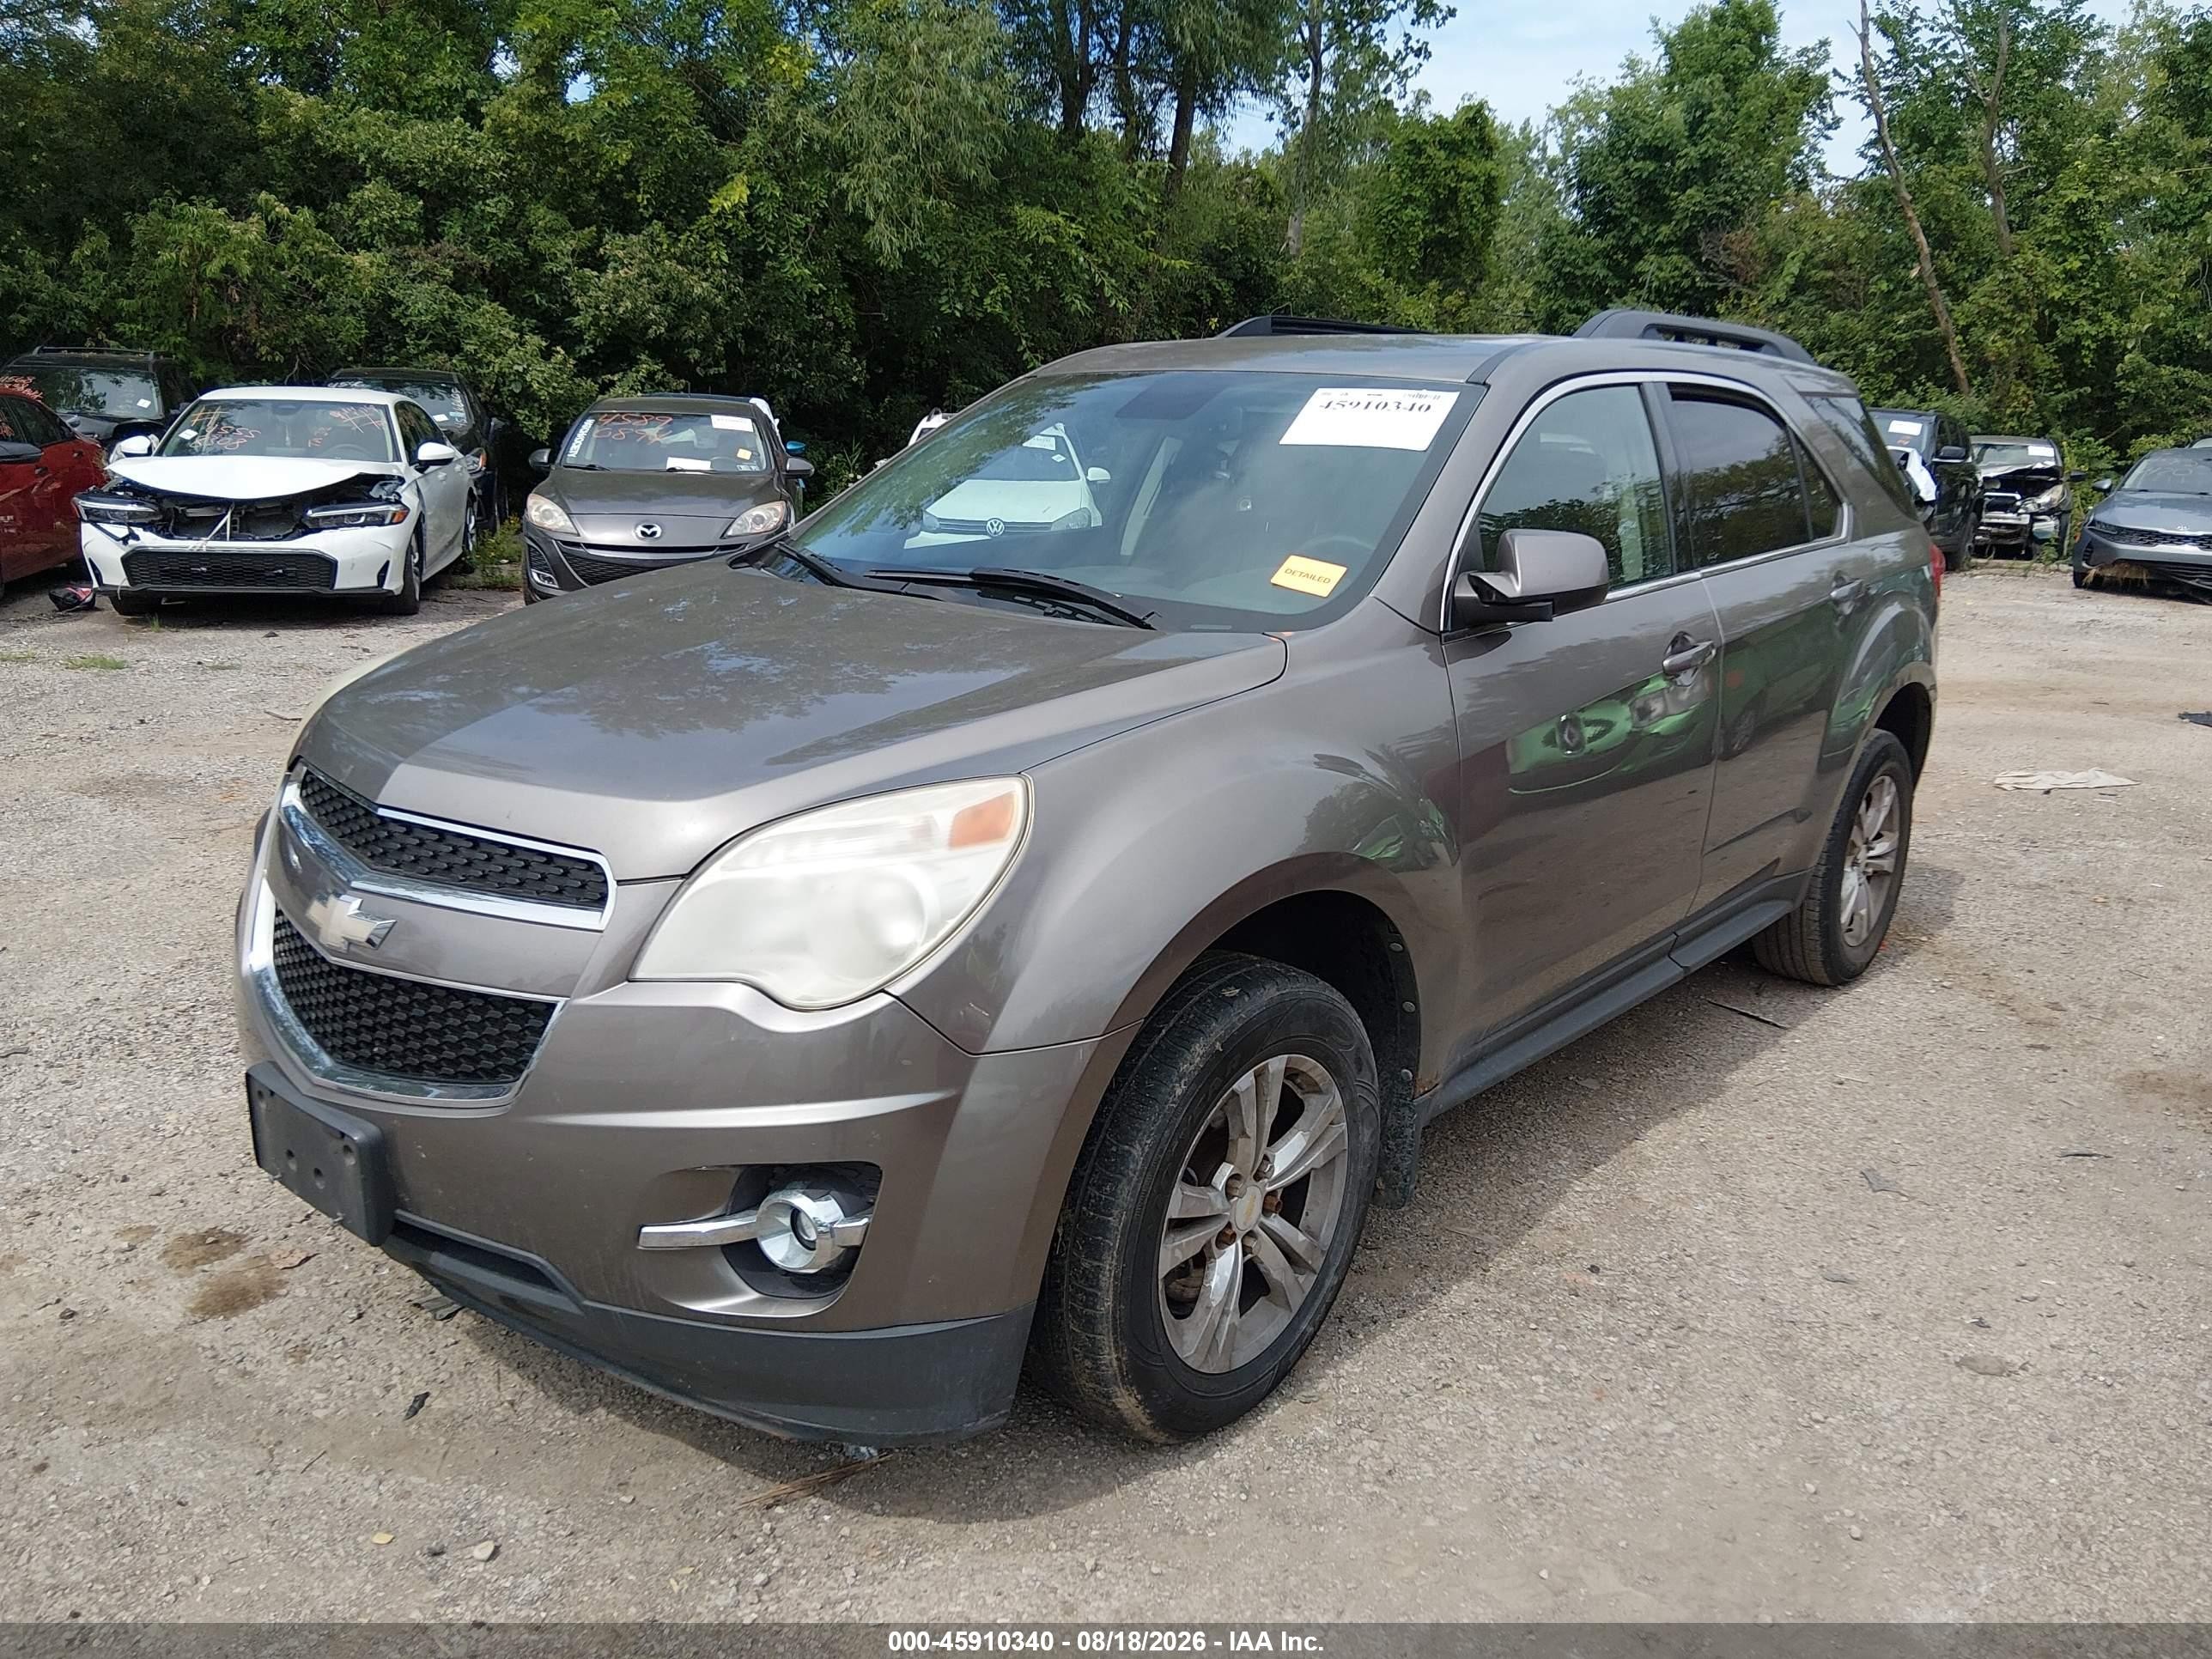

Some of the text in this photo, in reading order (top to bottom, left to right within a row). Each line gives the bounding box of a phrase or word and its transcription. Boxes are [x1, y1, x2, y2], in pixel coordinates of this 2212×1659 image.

[1319, 400, 1432, 413] 45910340
[599, 413, 673, 430] 4589
[1285, 568, 1331, 584] DETAILED
